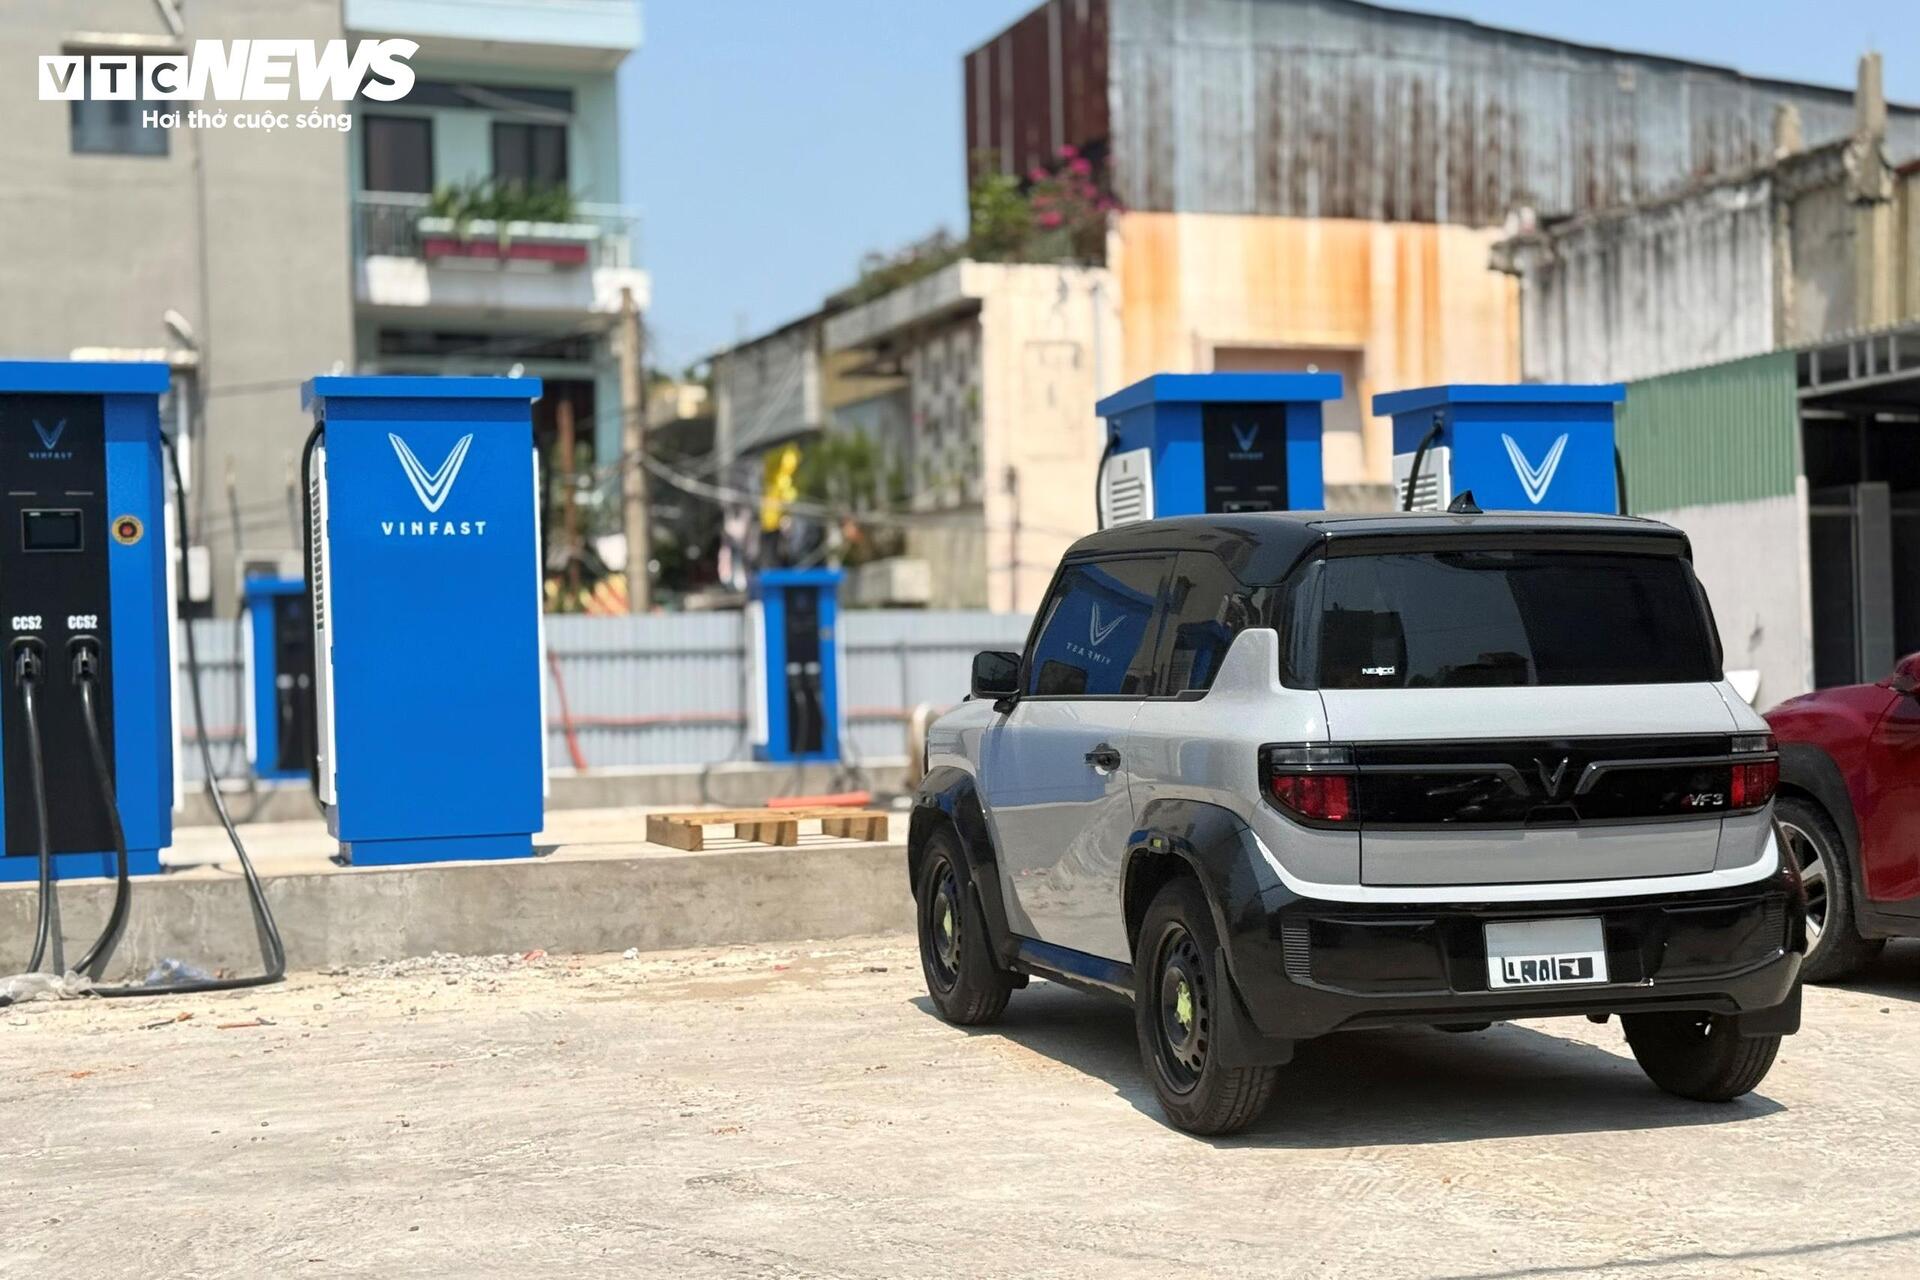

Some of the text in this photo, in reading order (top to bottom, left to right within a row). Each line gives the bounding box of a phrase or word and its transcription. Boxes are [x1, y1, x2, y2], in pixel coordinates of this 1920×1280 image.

[381, 521, 486, 536] VINFAST
[12, 616, 42, 630] CCS2
[67, 615, 98, 629] CCS2
